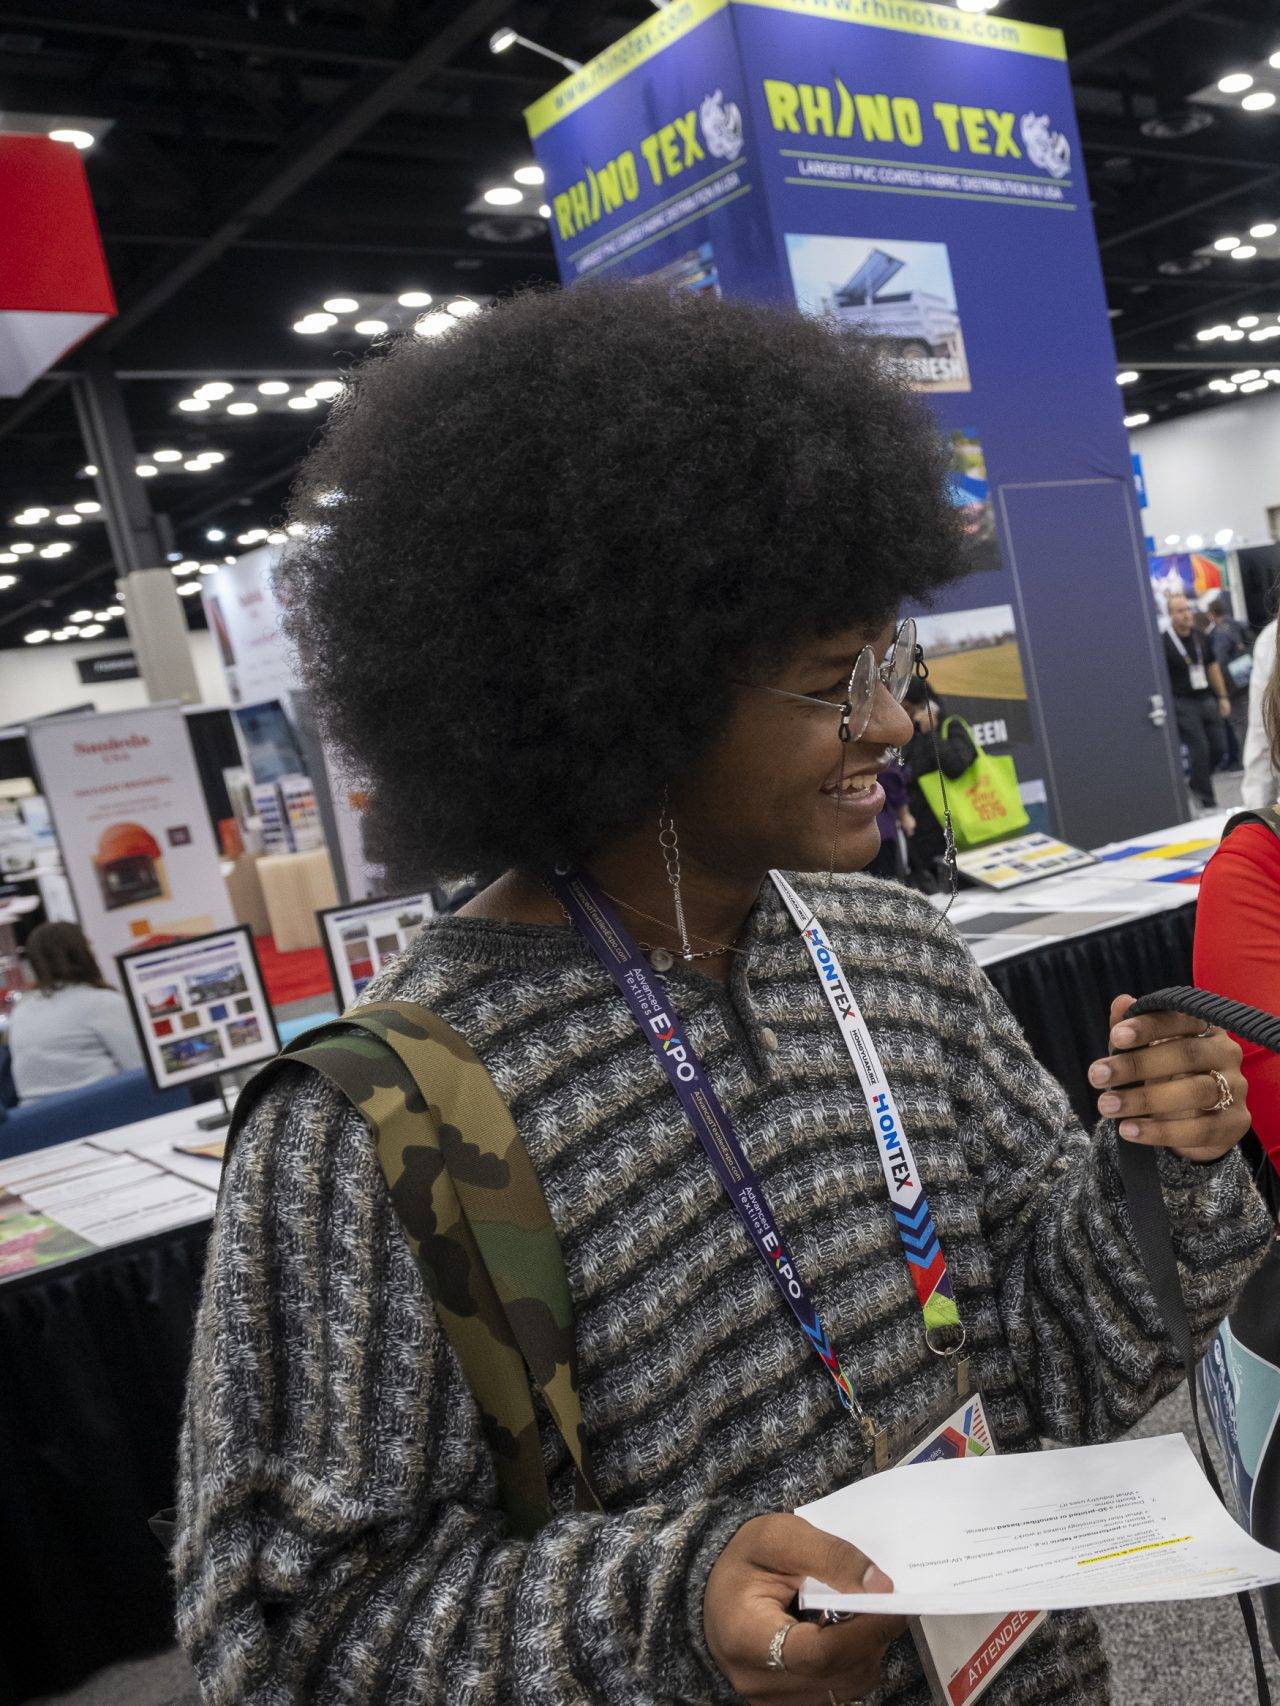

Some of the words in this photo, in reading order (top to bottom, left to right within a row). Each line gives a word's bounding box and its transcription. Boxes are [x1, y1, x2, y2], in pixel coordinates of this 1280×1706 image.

[794, 0, 1020, 43] ww.rhinotex.com
[763, 72, 923, 148] RHINO
[932, 102, 1022, 159] TEX
[553, 149, 640, 241] RHINO
[640, 110, 704, 187] TEX
[623, 970, 652, 1016] Textiles
[633, 968, 663, 1011] Advanced
[804, 928, 855, 1021] HONTEX
[649, 1012, 695, 1082] EXPO
[851, 1029, 877, 1085] HONGYUAN.BIZ
[872, 1093, 914, 1192] HONTEX
[739, 1190, 764, 1235] Textiles
[744, 1186, 770, 1230] Advanced
[762, 1230, 801, 1299] EXPO
[966, 1610, 1029, 1686] ATTENDEE
